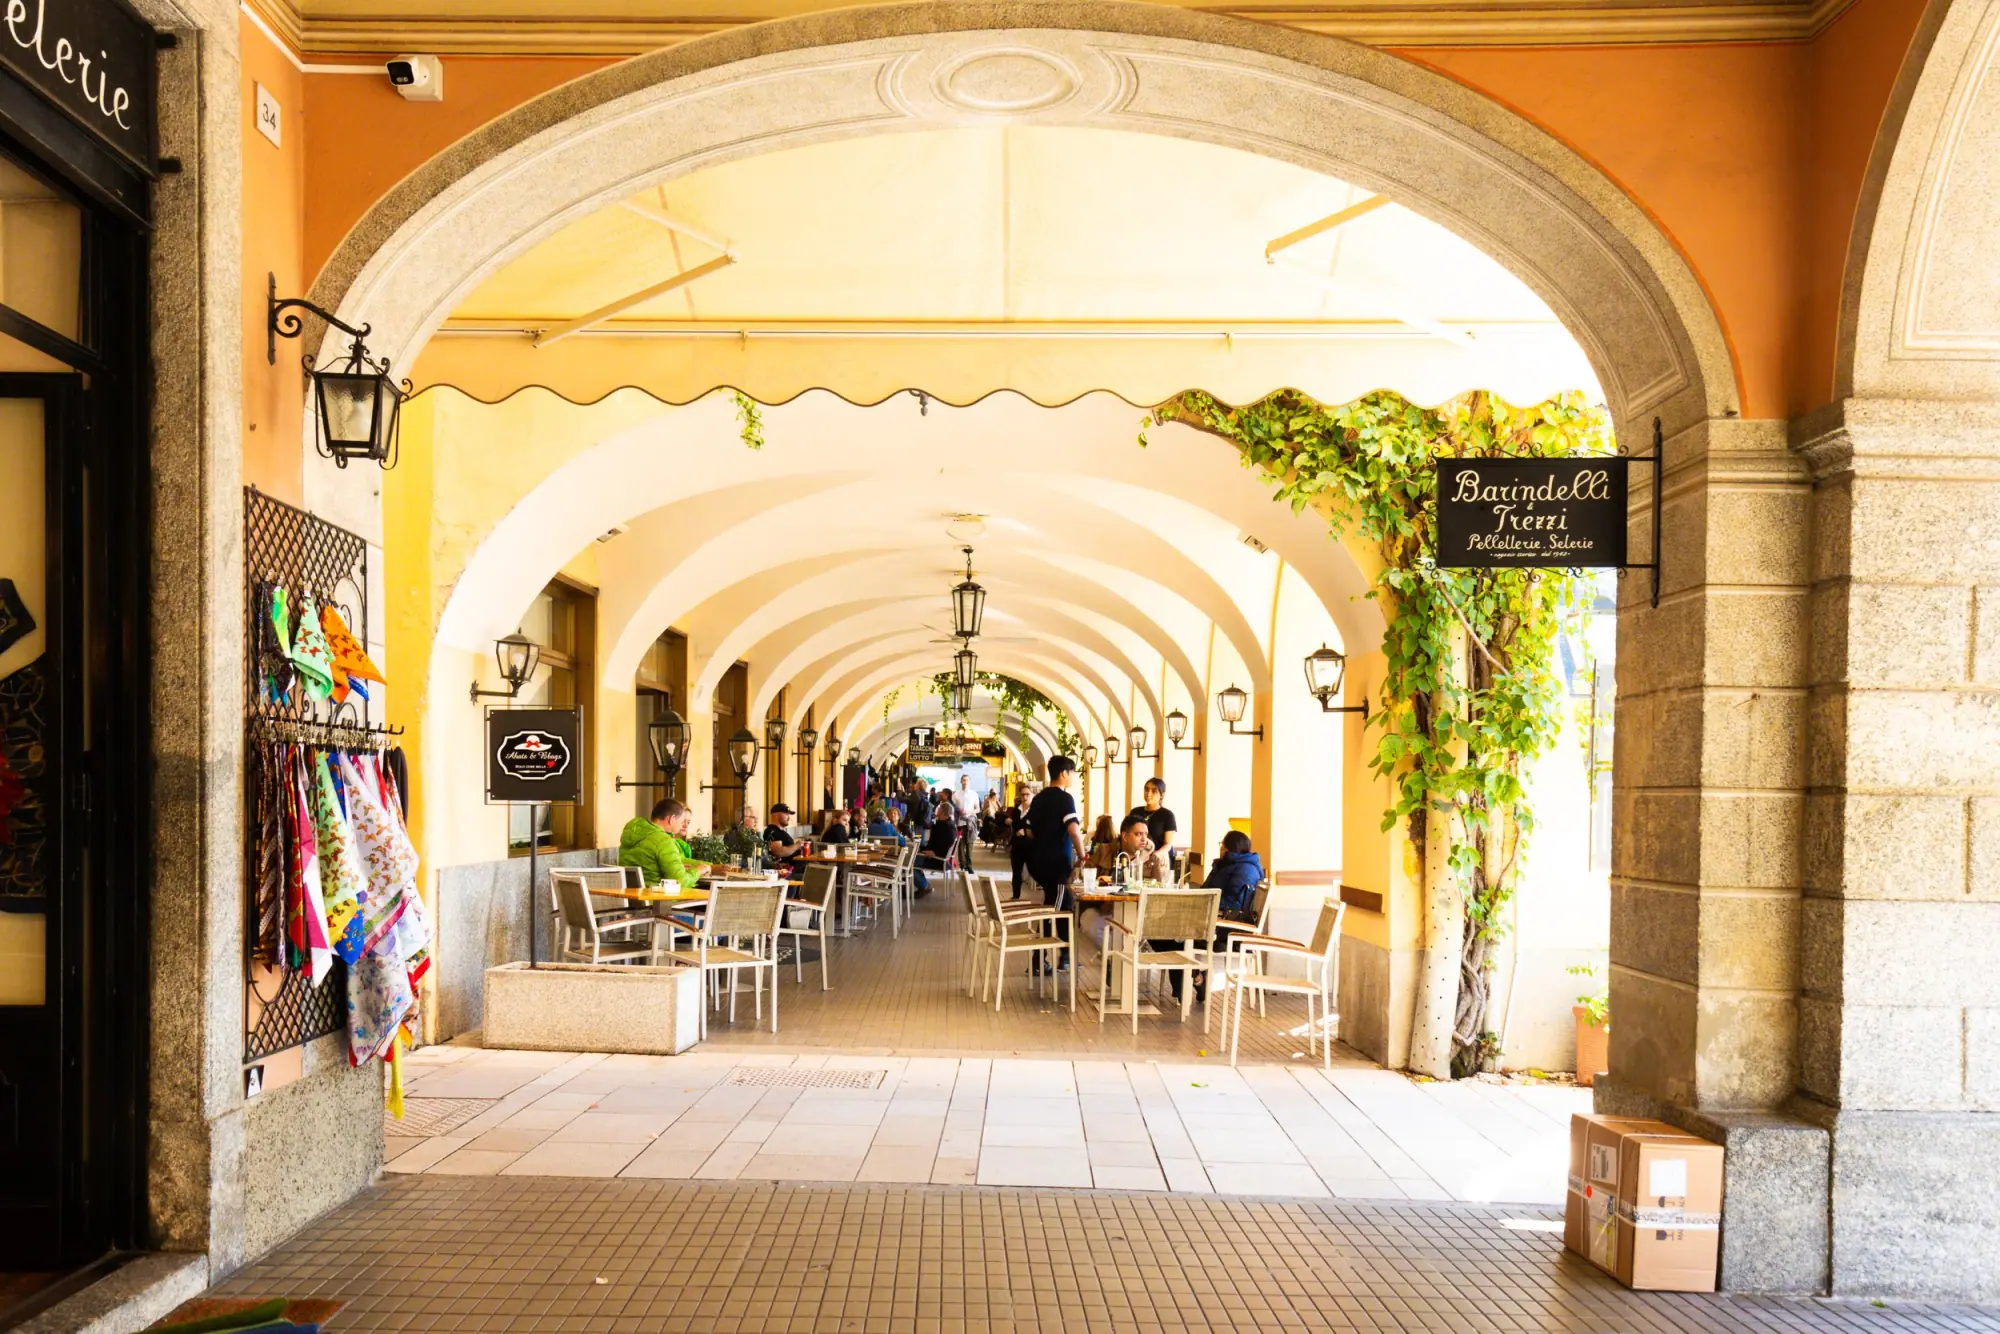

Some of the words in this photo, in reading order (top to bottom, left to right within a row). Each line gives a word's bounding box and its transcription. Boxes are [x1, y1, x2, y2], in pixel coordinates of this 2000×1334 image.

[261, 103, 277, 131] 34
[1451, 469, 1611, 503] Barindelli
[1492, 503, 1569, 533] Trezzi
[1549, 533, 1594, 549] Selerie
[914, 729, 930, 745] T
[530, 752, 537, 760] &
